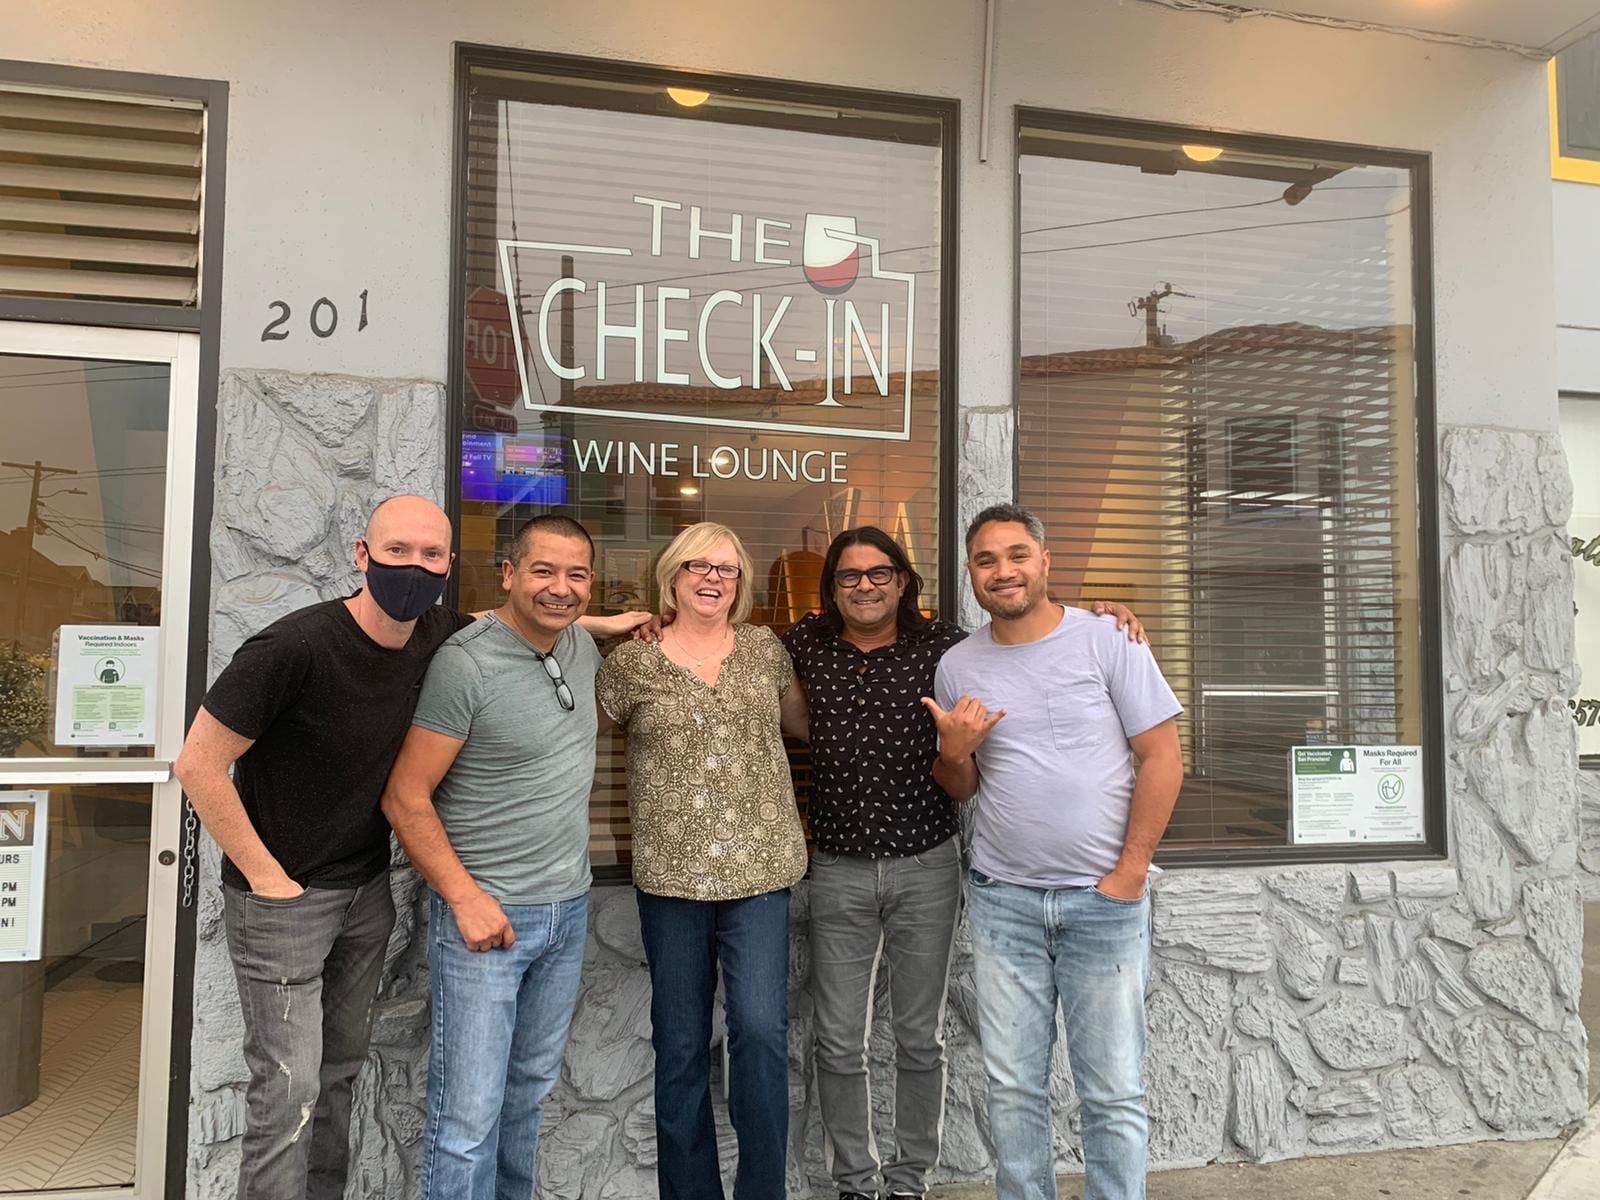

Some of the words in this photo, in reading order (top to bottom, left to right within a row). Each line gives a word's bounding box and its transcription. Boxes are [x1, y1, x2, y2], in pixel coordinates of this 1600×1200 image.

[633, 195, 792, 266] THE
[261, 289, 368, 342] 201
[538, 277, 889, 407] CHECK-IN
[572, 438, 679, 477] WINE
[692, 444, 849, 484] LOUNGE
[1386, 750, 1417, 758] Required
[1, 897, 16, 907] PM
[2, 882, 17, 891] PM
